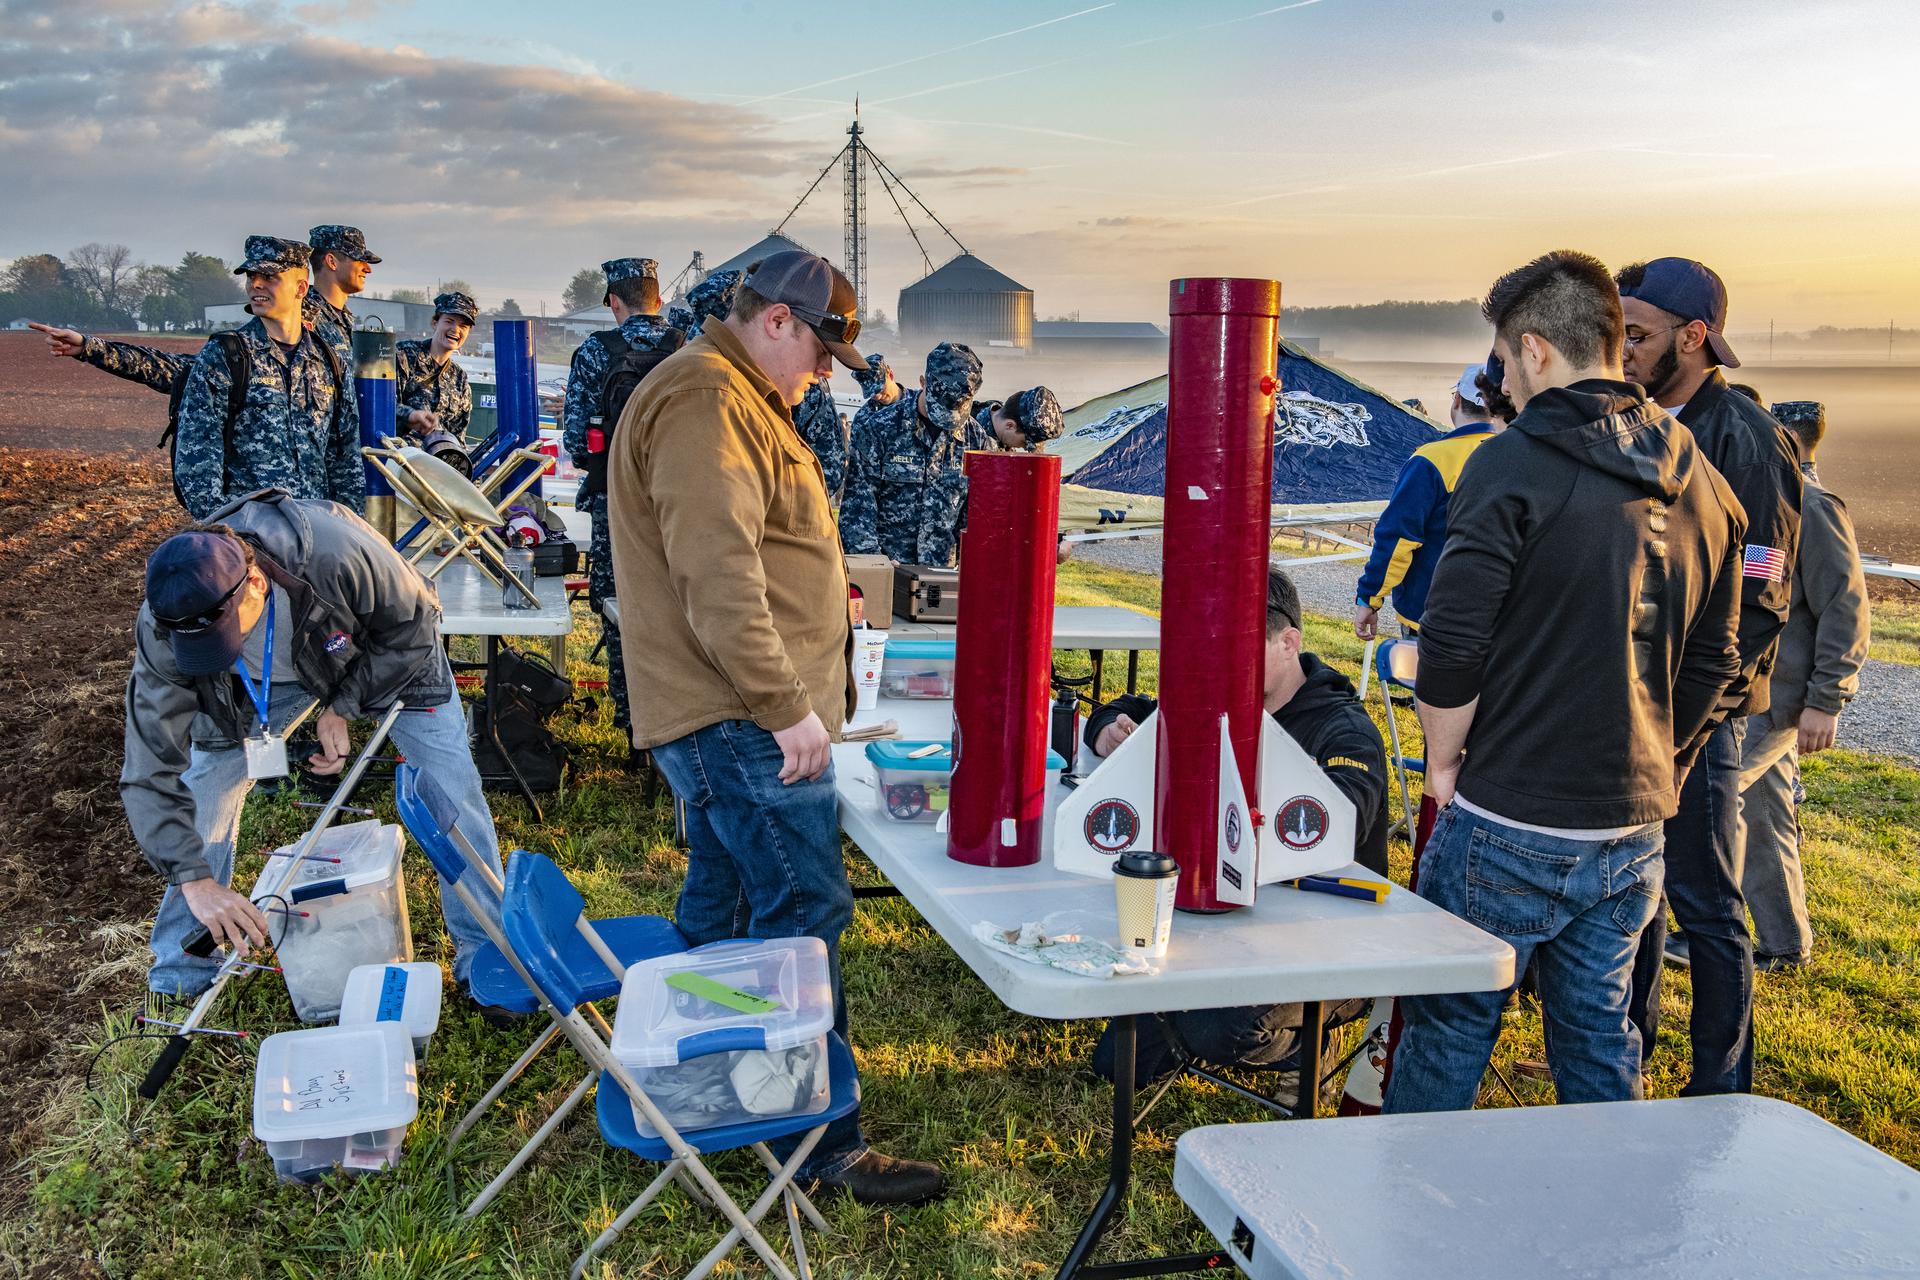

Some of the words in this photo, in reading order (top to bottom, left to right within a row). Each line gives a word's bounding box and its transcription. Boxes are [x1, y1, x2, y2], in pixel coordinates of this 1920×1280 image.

[891, 455, 914, 464] KELLY
[1096, 509, 1126, 525] N
[1327, 756, 1369, 772] WAGNER
